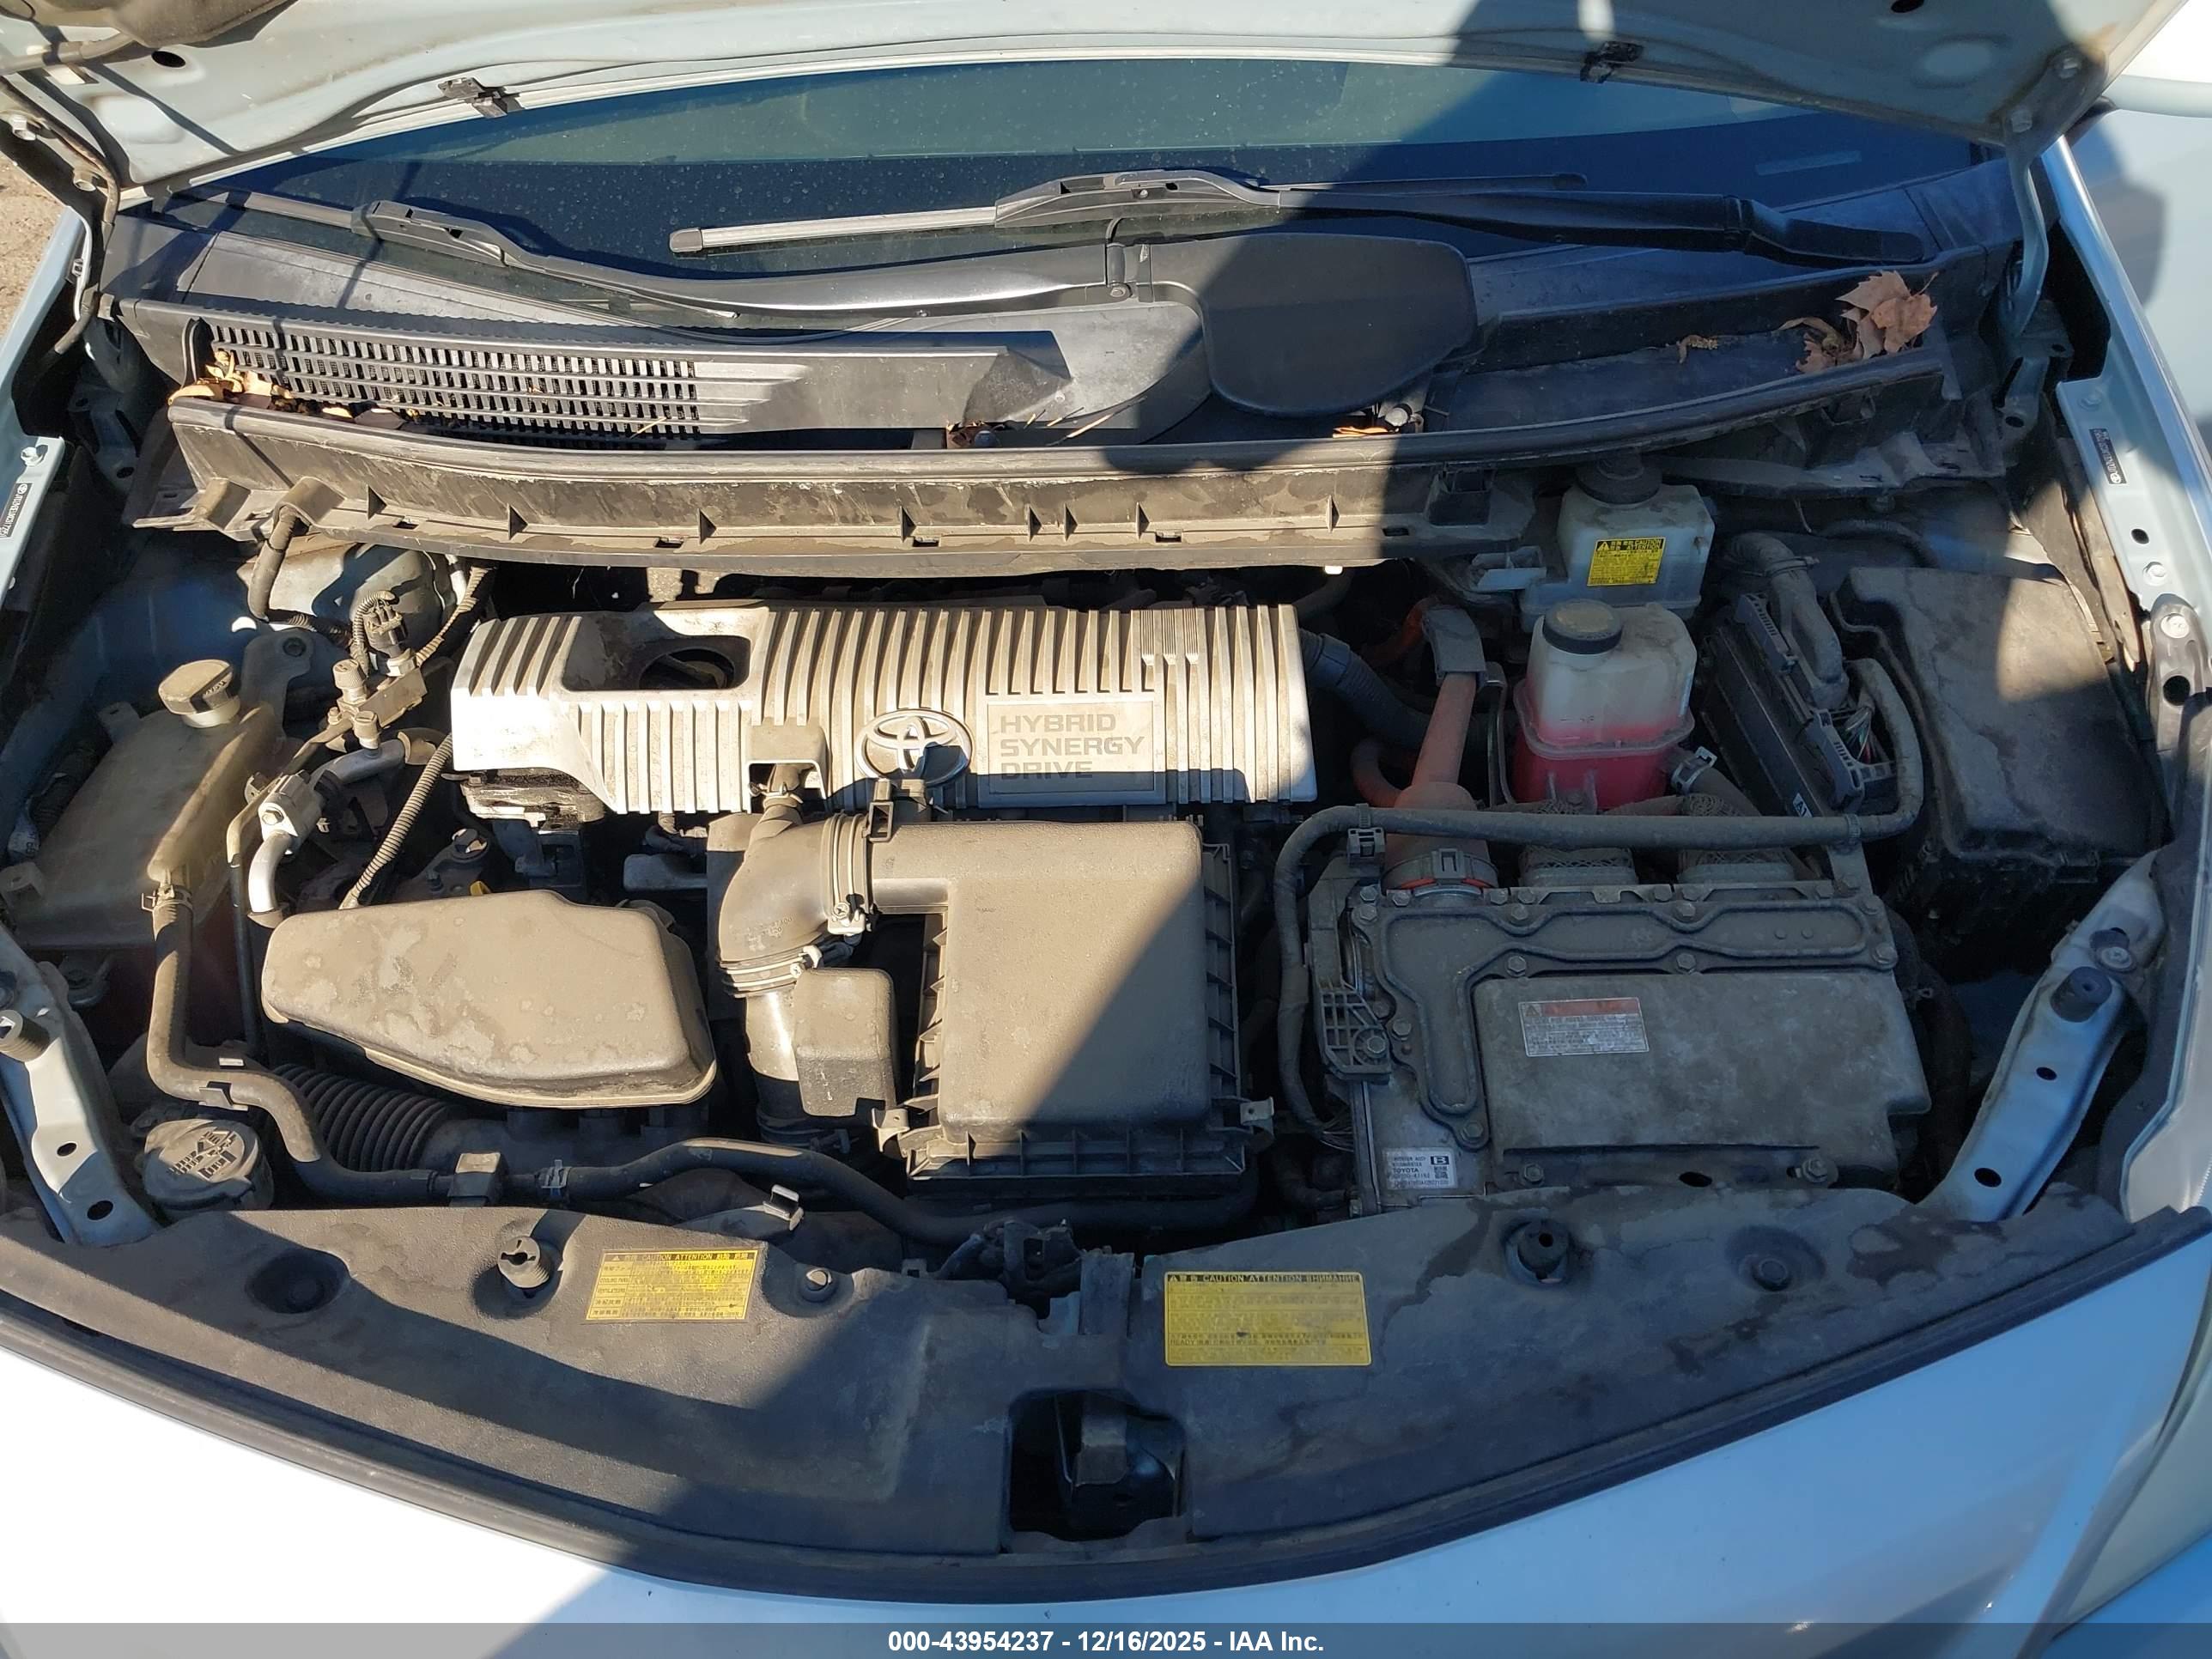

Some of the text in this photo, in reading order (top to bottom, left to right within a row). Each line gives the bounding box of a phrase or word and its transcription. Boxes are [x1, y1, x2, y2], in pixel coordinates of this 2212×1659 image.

[1000, 714, 1116, 733] HYBRID
[1000, 736, 1145, 757] SYNERGY
[1000, 761, 1093, 780] DRIVE
[1202, 1274, 1244, 1283] CAUTION
[1249, 1274, 1301, 1283] ATTENTION
